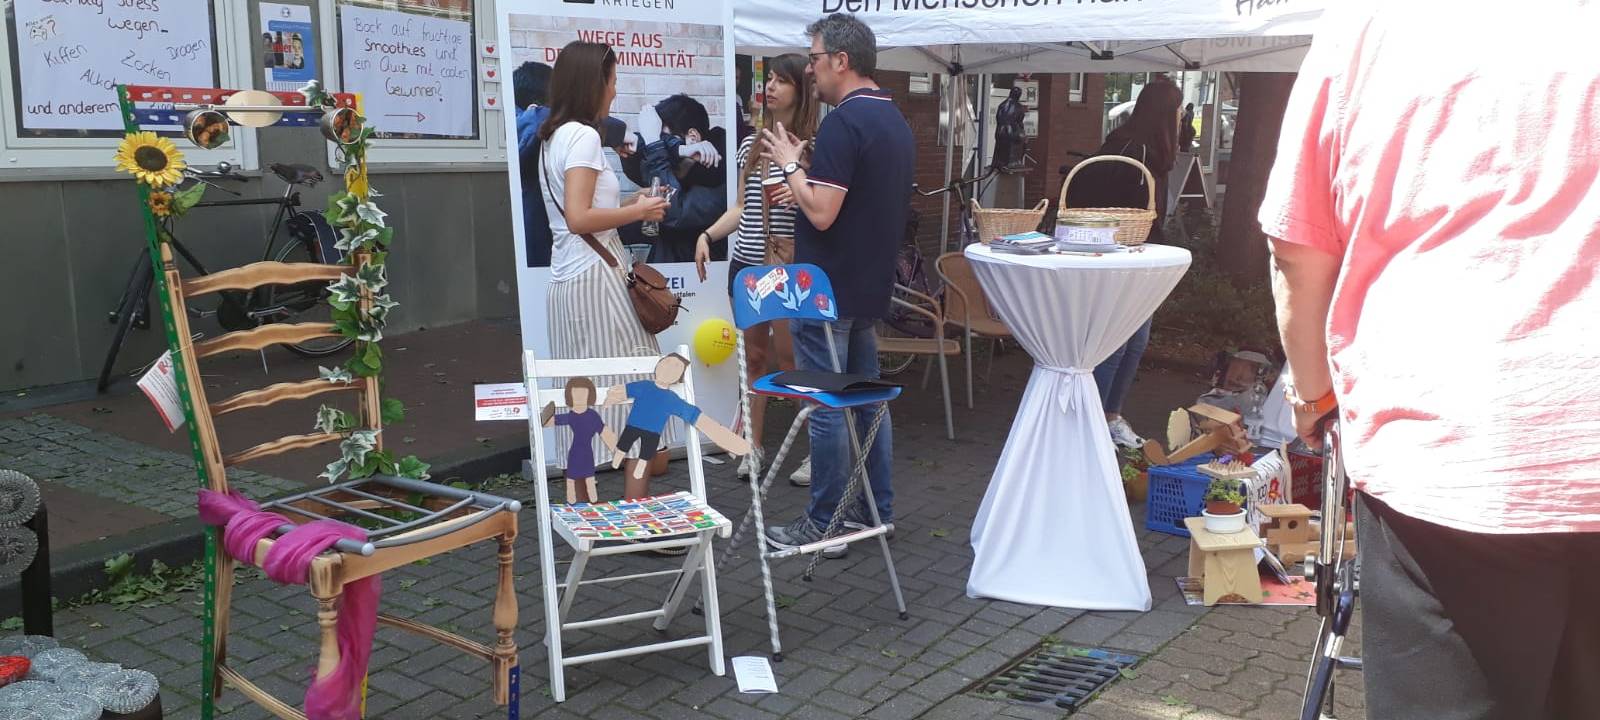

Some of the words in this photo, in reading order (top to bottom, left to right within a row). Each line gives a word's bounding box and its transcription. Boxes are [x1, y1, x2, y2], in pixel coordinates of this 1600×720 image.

[353, 17, 382, 34] Bock
[391, 18, 413, 37] auf
[364, 38, 426, 58] Smoothies
[435, 47, 458, 61] und
[577, 30, 625, 47] WEGE
[630, 33, 663, 49] AUS
[43, 44, 88, 68] Kiffen
[120, 48, 172, 83] Zocken
[380, 55, 409, 74] Quiz
[416, 62, 435, 77] mit
[27, 100, 54, 115] und
[58, 100, 120, 115] anderem
